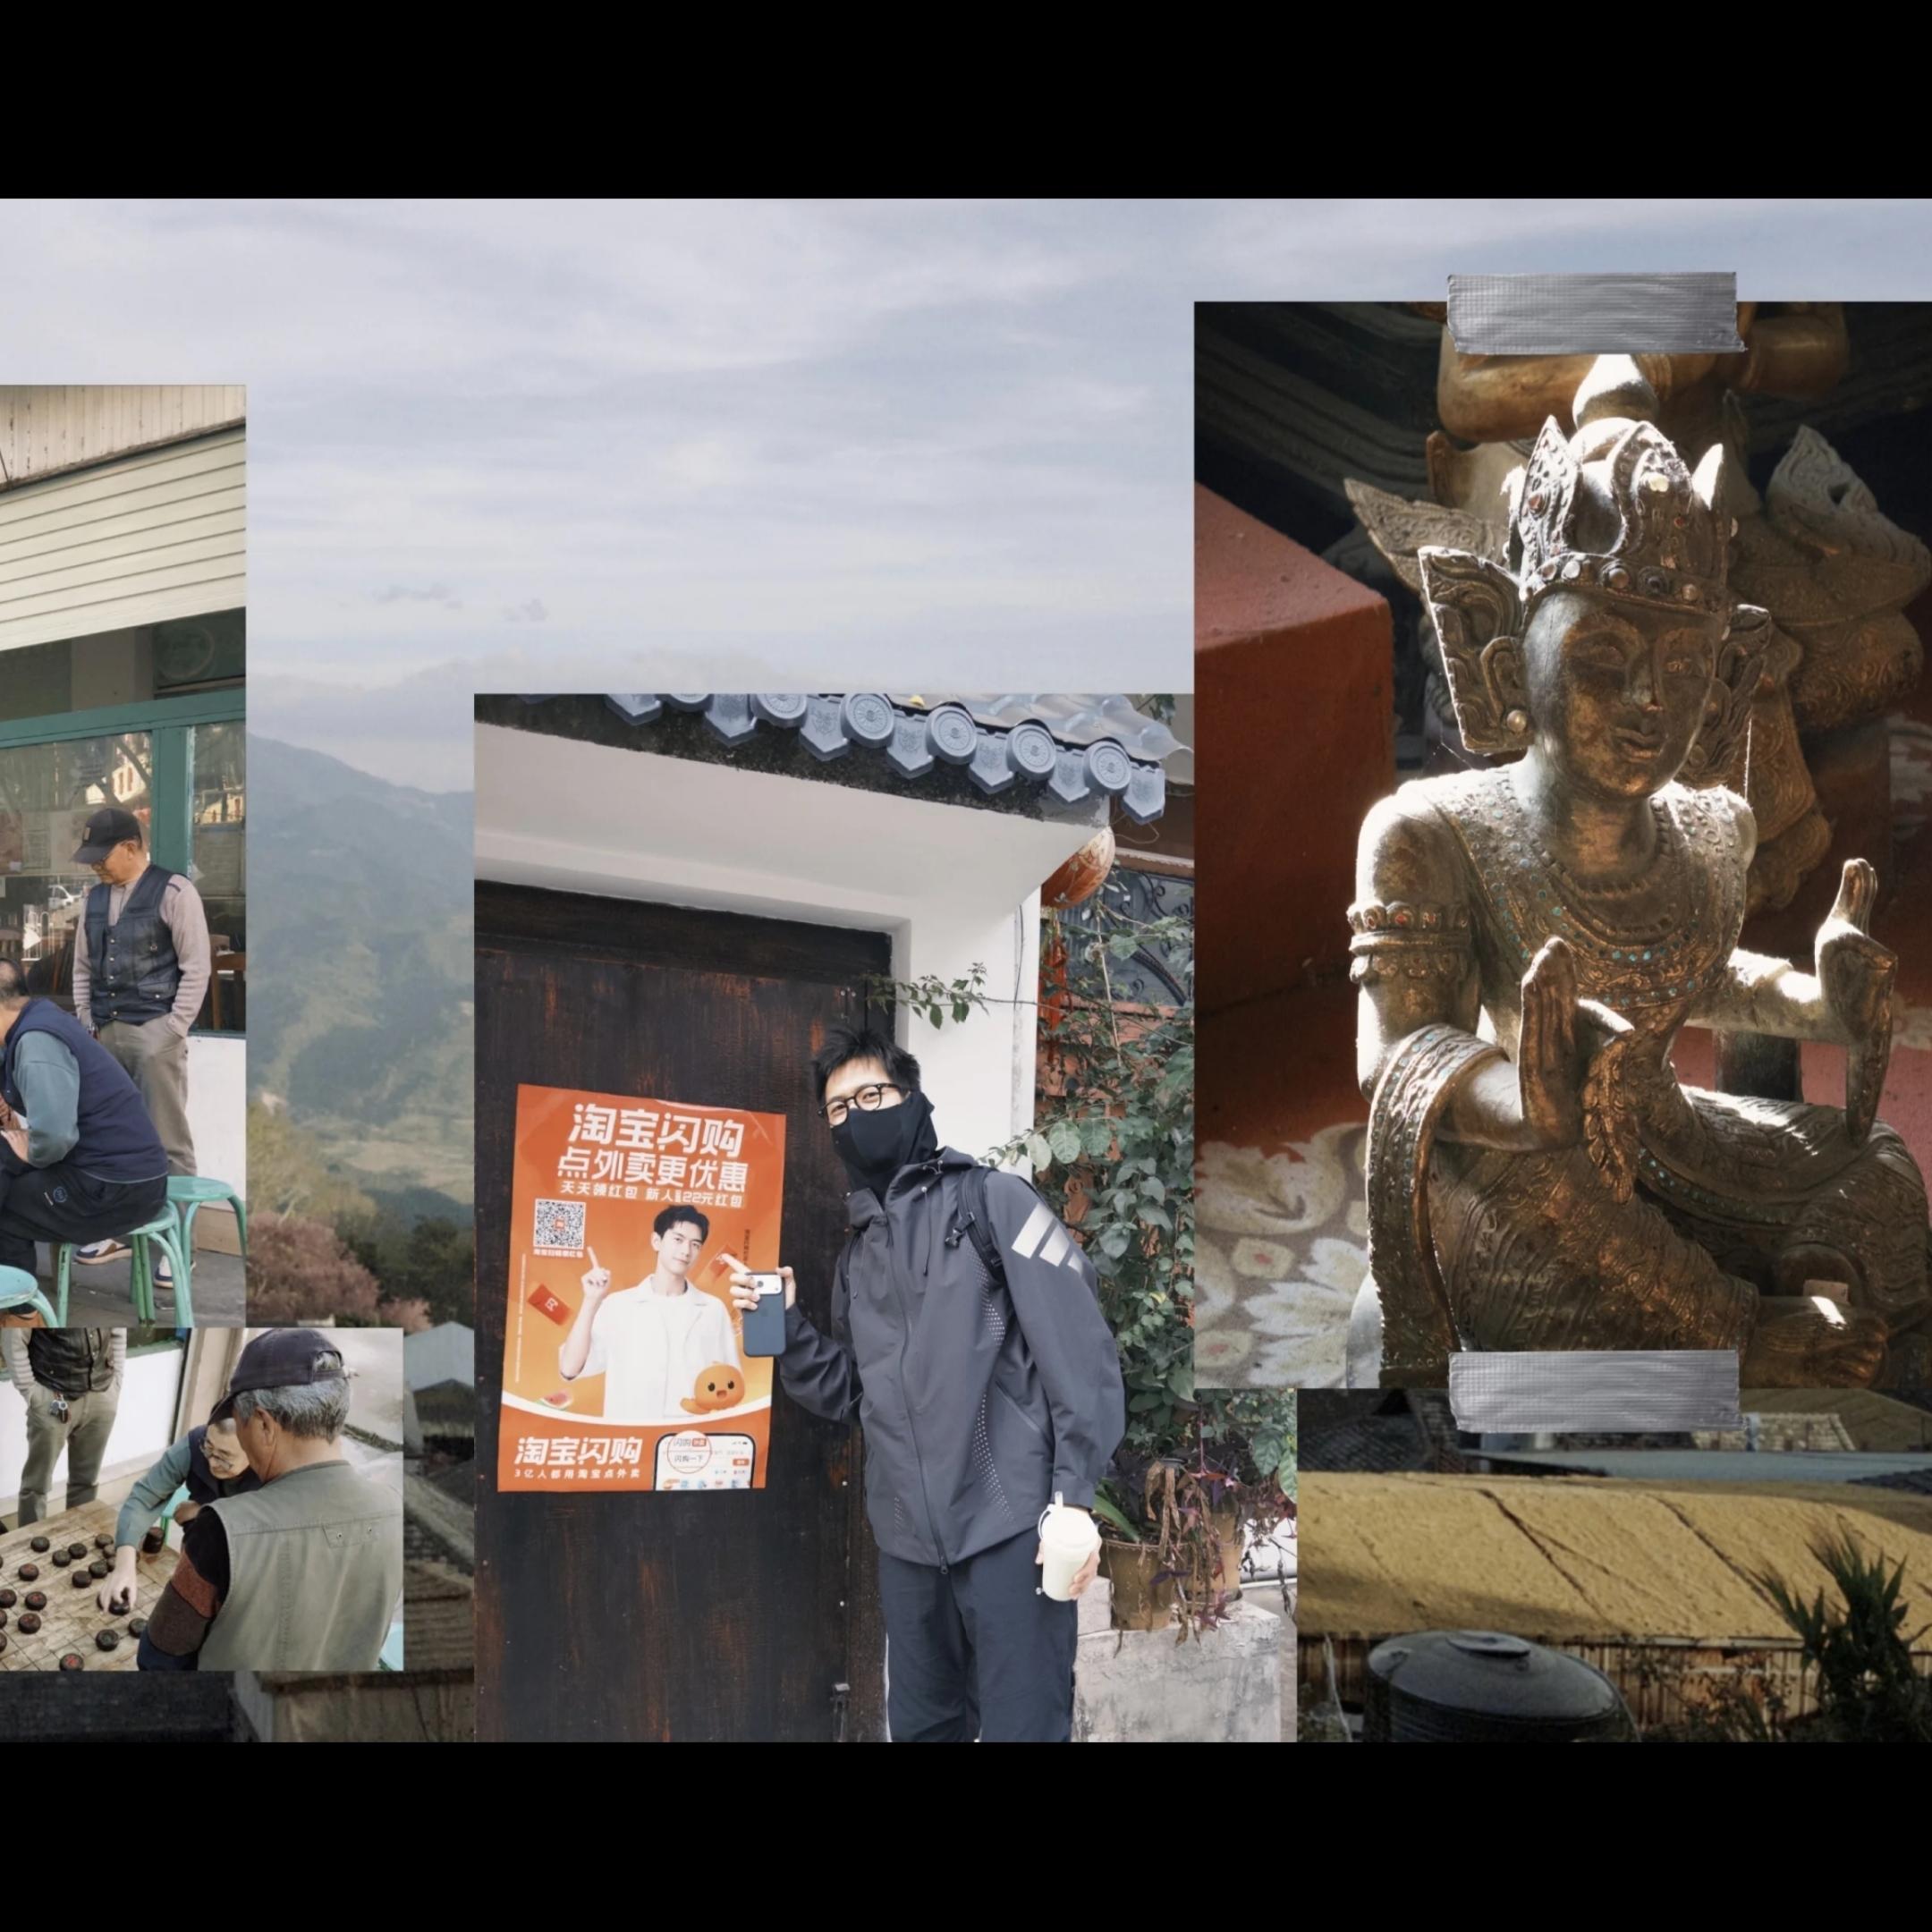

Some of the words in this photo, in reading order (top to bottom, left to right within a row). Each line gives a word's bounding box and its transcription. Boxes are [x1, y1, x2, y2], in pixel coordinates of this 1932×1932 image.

[568, 1103, 744, 1157] 淘宝闪购
[557, 1146, 749, 1192] 点外卖更优惠
[560, 1181, 638, 1199] 天天领红包
[514, 1436, 643, 1466] 淘宝闪购
